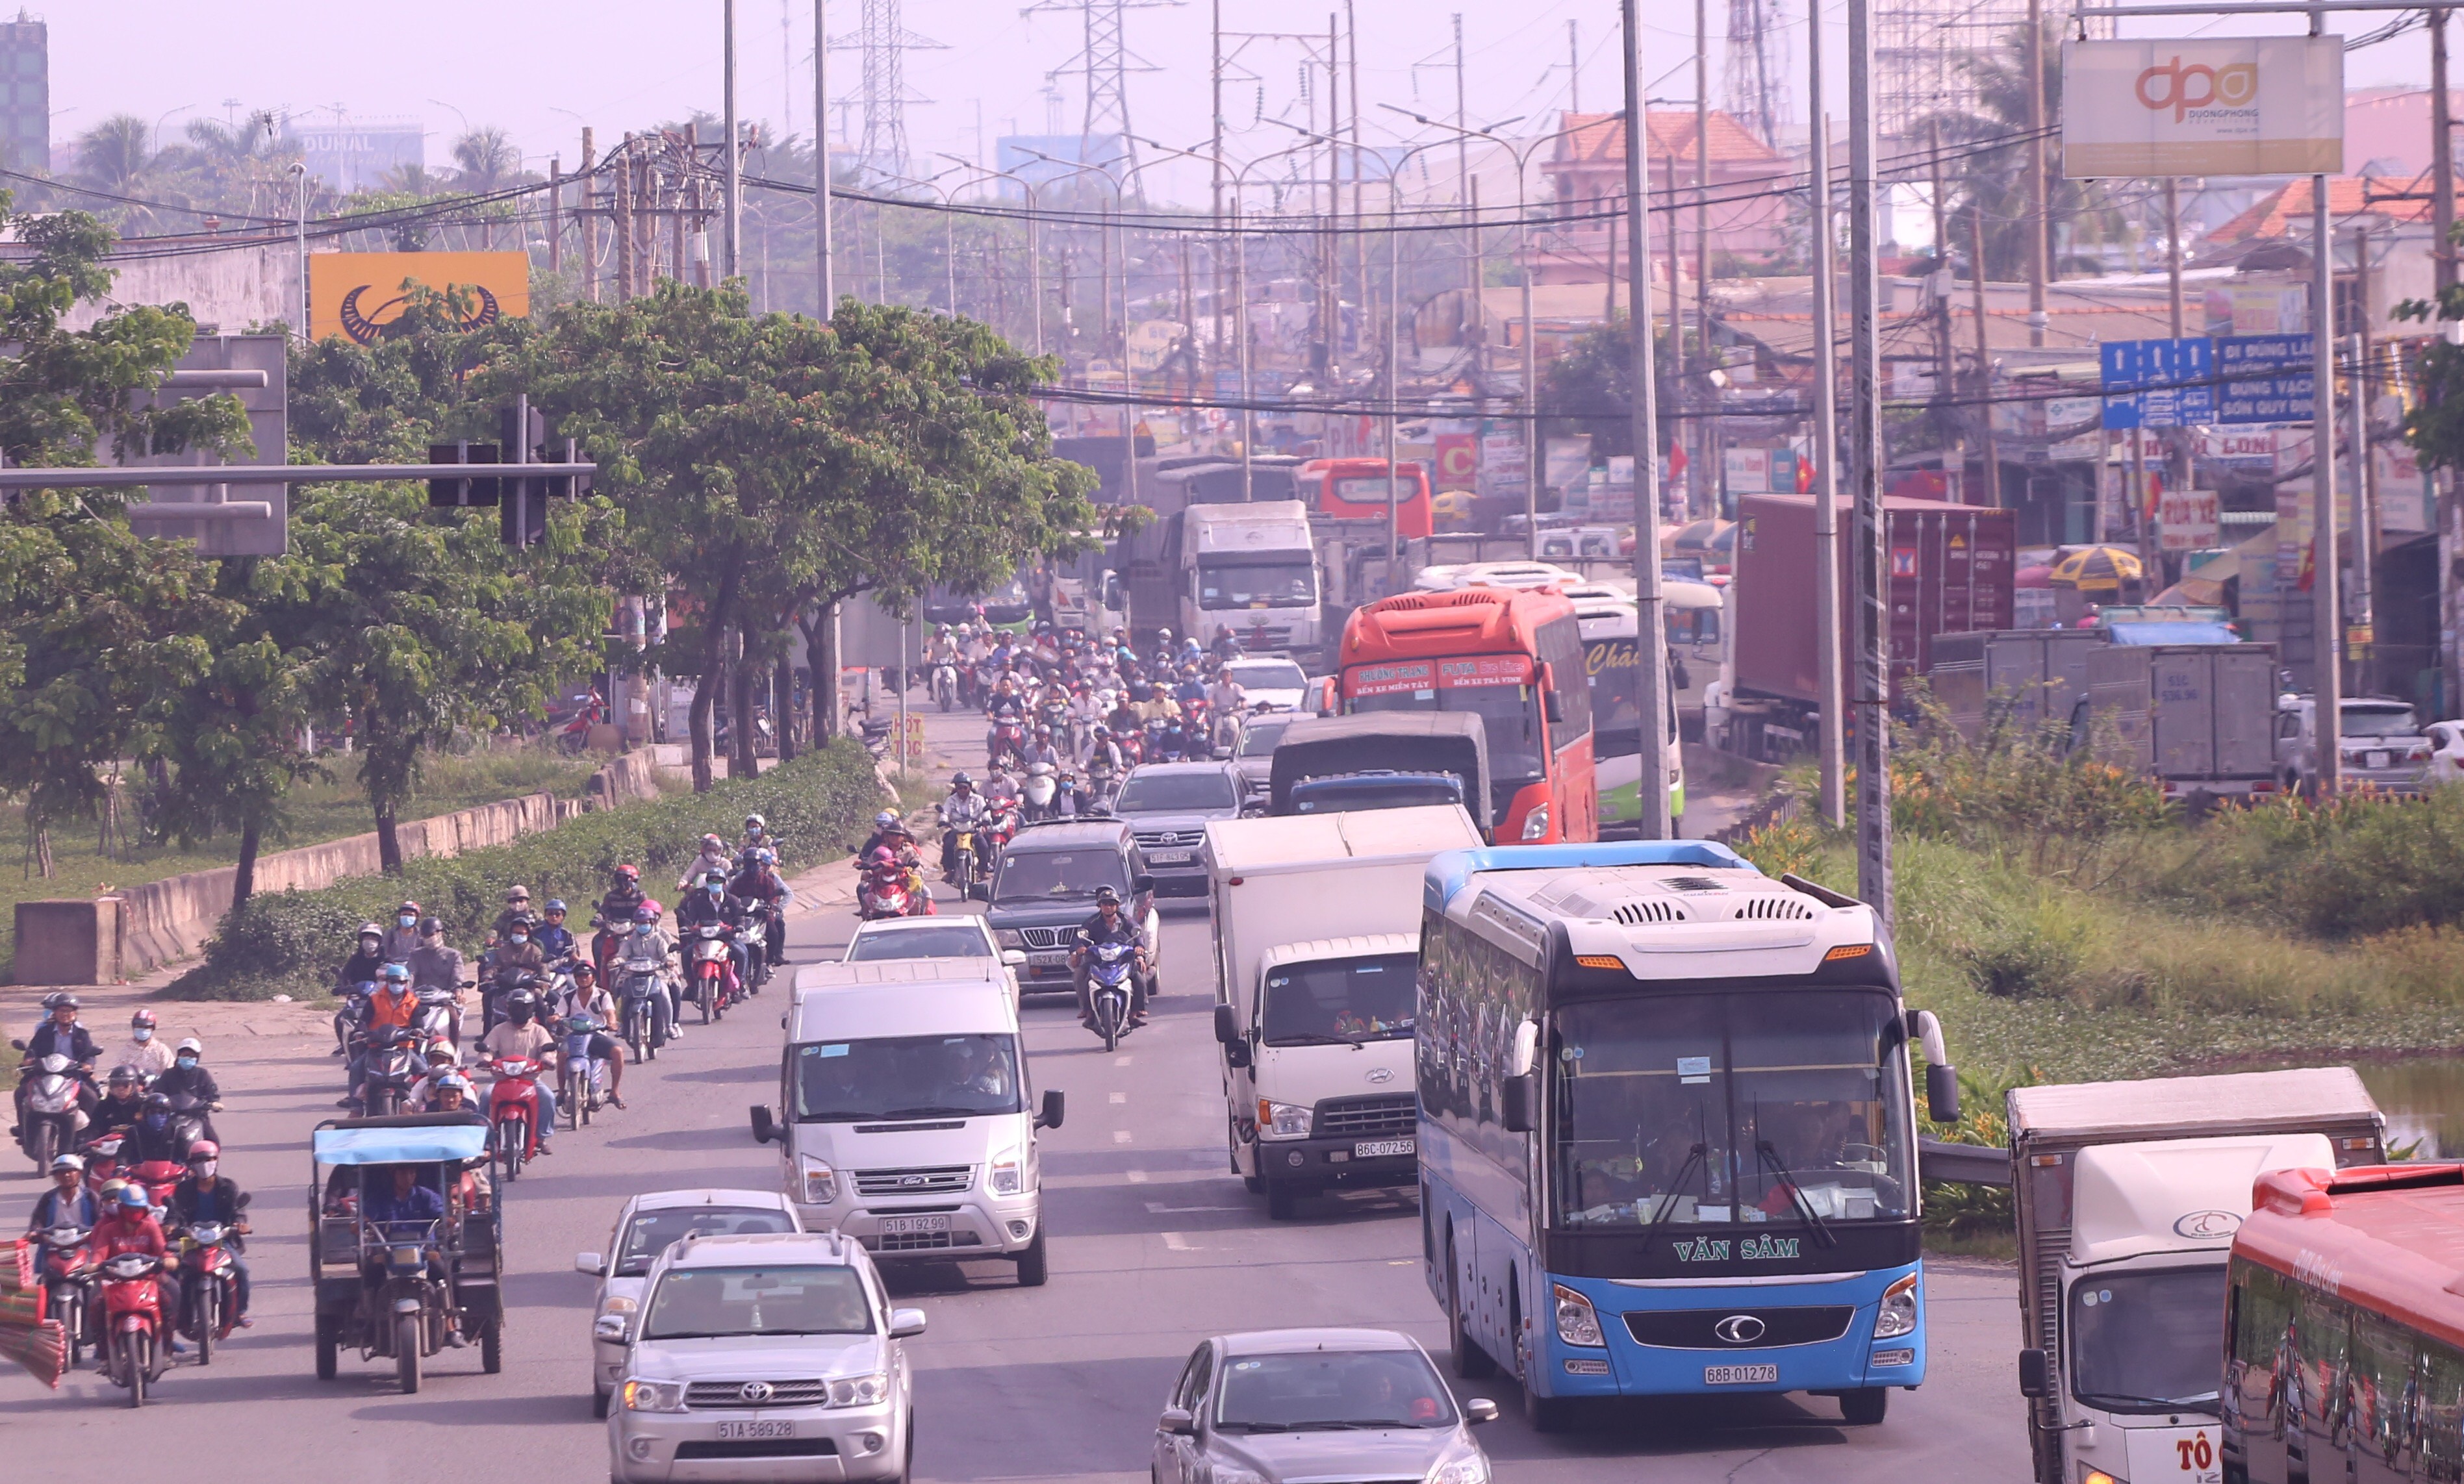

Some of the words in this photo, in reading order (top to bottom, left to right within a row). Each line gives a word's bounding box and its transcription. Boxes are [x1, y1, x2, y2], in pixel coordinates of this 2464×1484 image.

[2189, 108, 2259, 118] DUONGPHONG
[1397, 664, 1429, 678] TRANG
[1442, 662, 1477, 676] FUTA
[1500, 660, 1525, 673] Lines
[1673, 1236, 1731, 1261] VĂN
[1740, 1233, 1800, 1259] SÂM
[1707, 1366, 1775, 1383] 68B-012.78
[2176, 1430, 2212, 1471] TÔ
